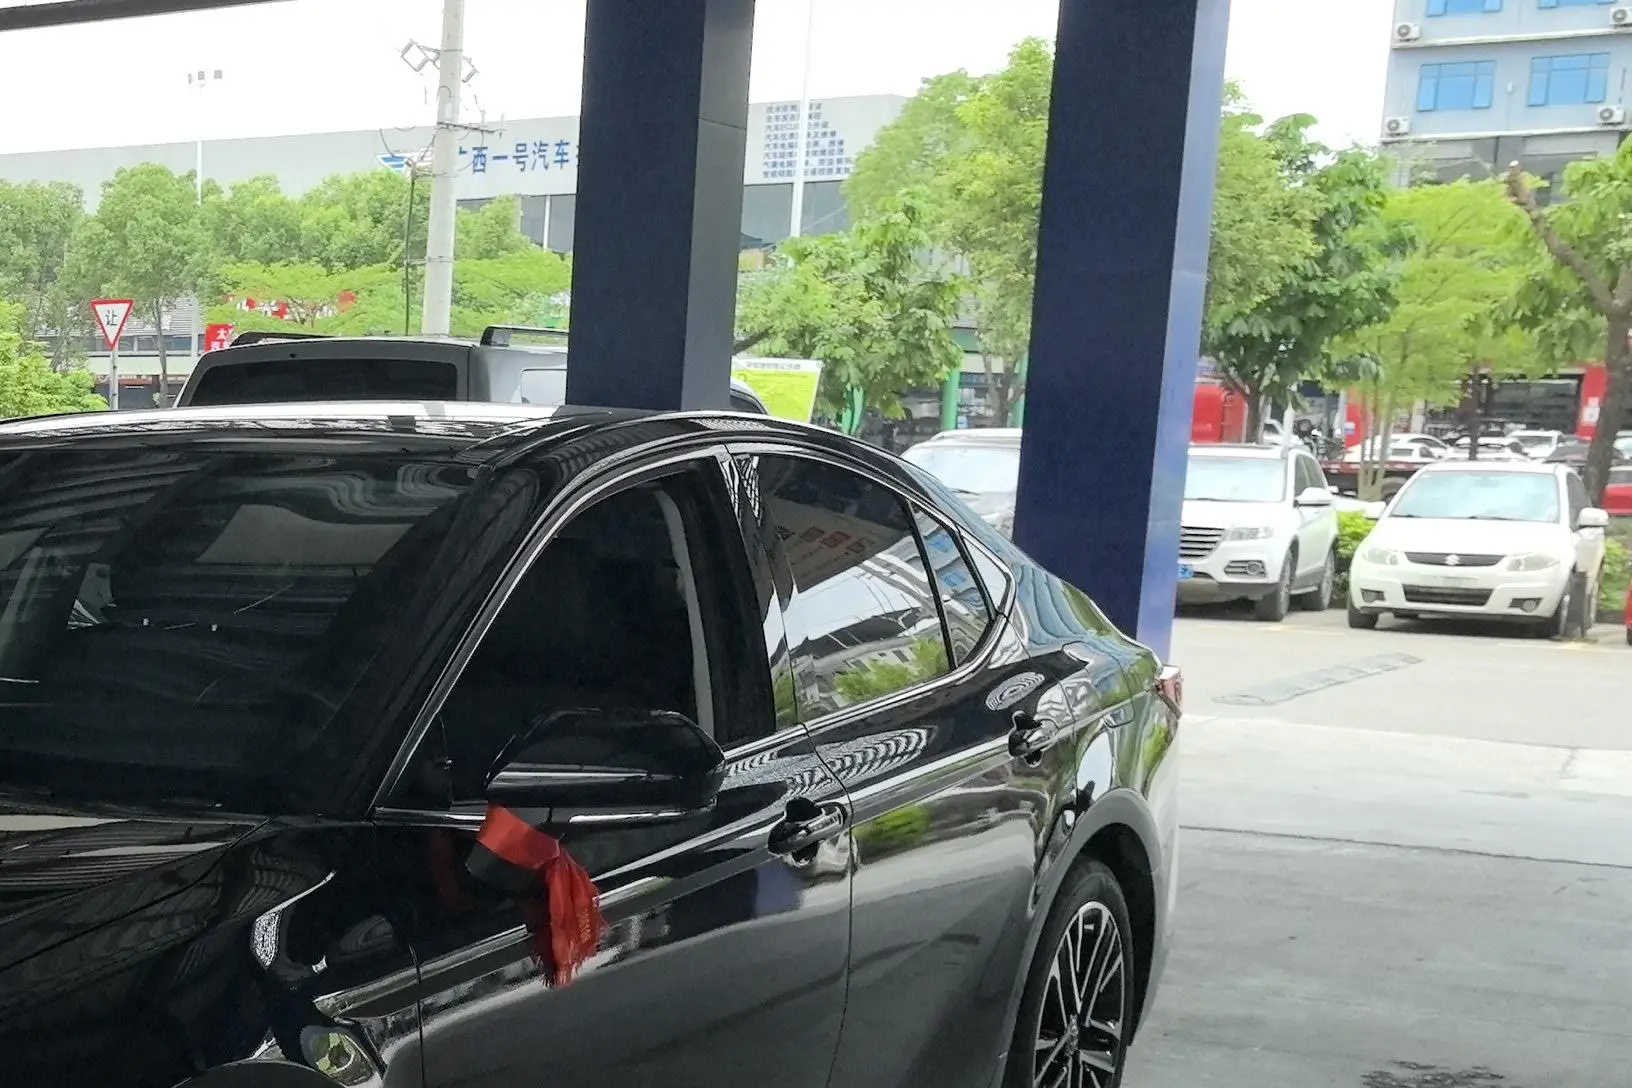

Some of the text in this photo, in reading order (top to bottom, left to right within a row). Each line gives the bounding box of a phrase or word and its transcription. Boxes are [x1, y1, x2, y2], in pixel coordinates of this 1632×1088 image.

[458, 139, 579, 174] 西一号汽车
[105, 309, 118, 326] 让
